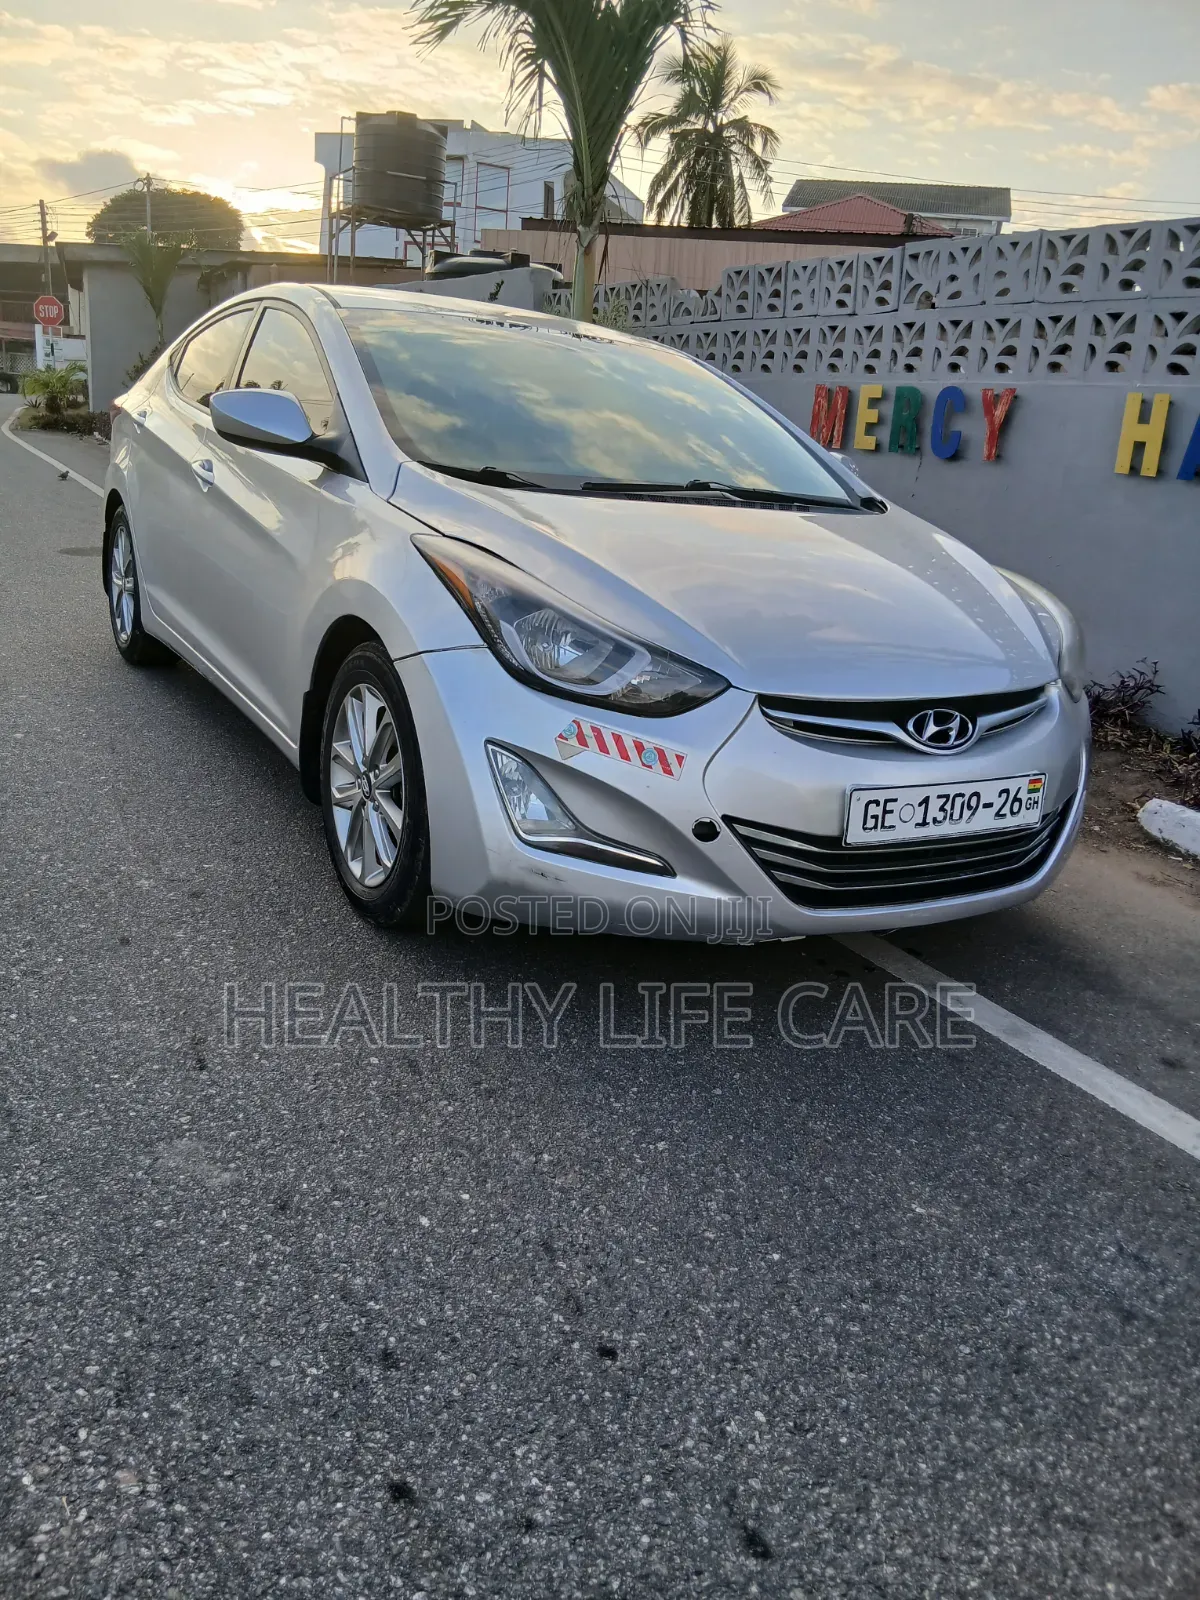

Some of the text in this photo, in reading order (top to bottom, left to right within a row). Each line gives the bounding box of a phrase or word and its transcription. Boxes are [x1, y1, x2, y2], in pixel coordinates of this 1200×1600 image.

[39, 305, 59, 318] STOP
[810, 383, 1017, 461] MERCY
[862, 786, 1022, 833] GE 1309-26
[1025, 796, 1039, 811] GH
